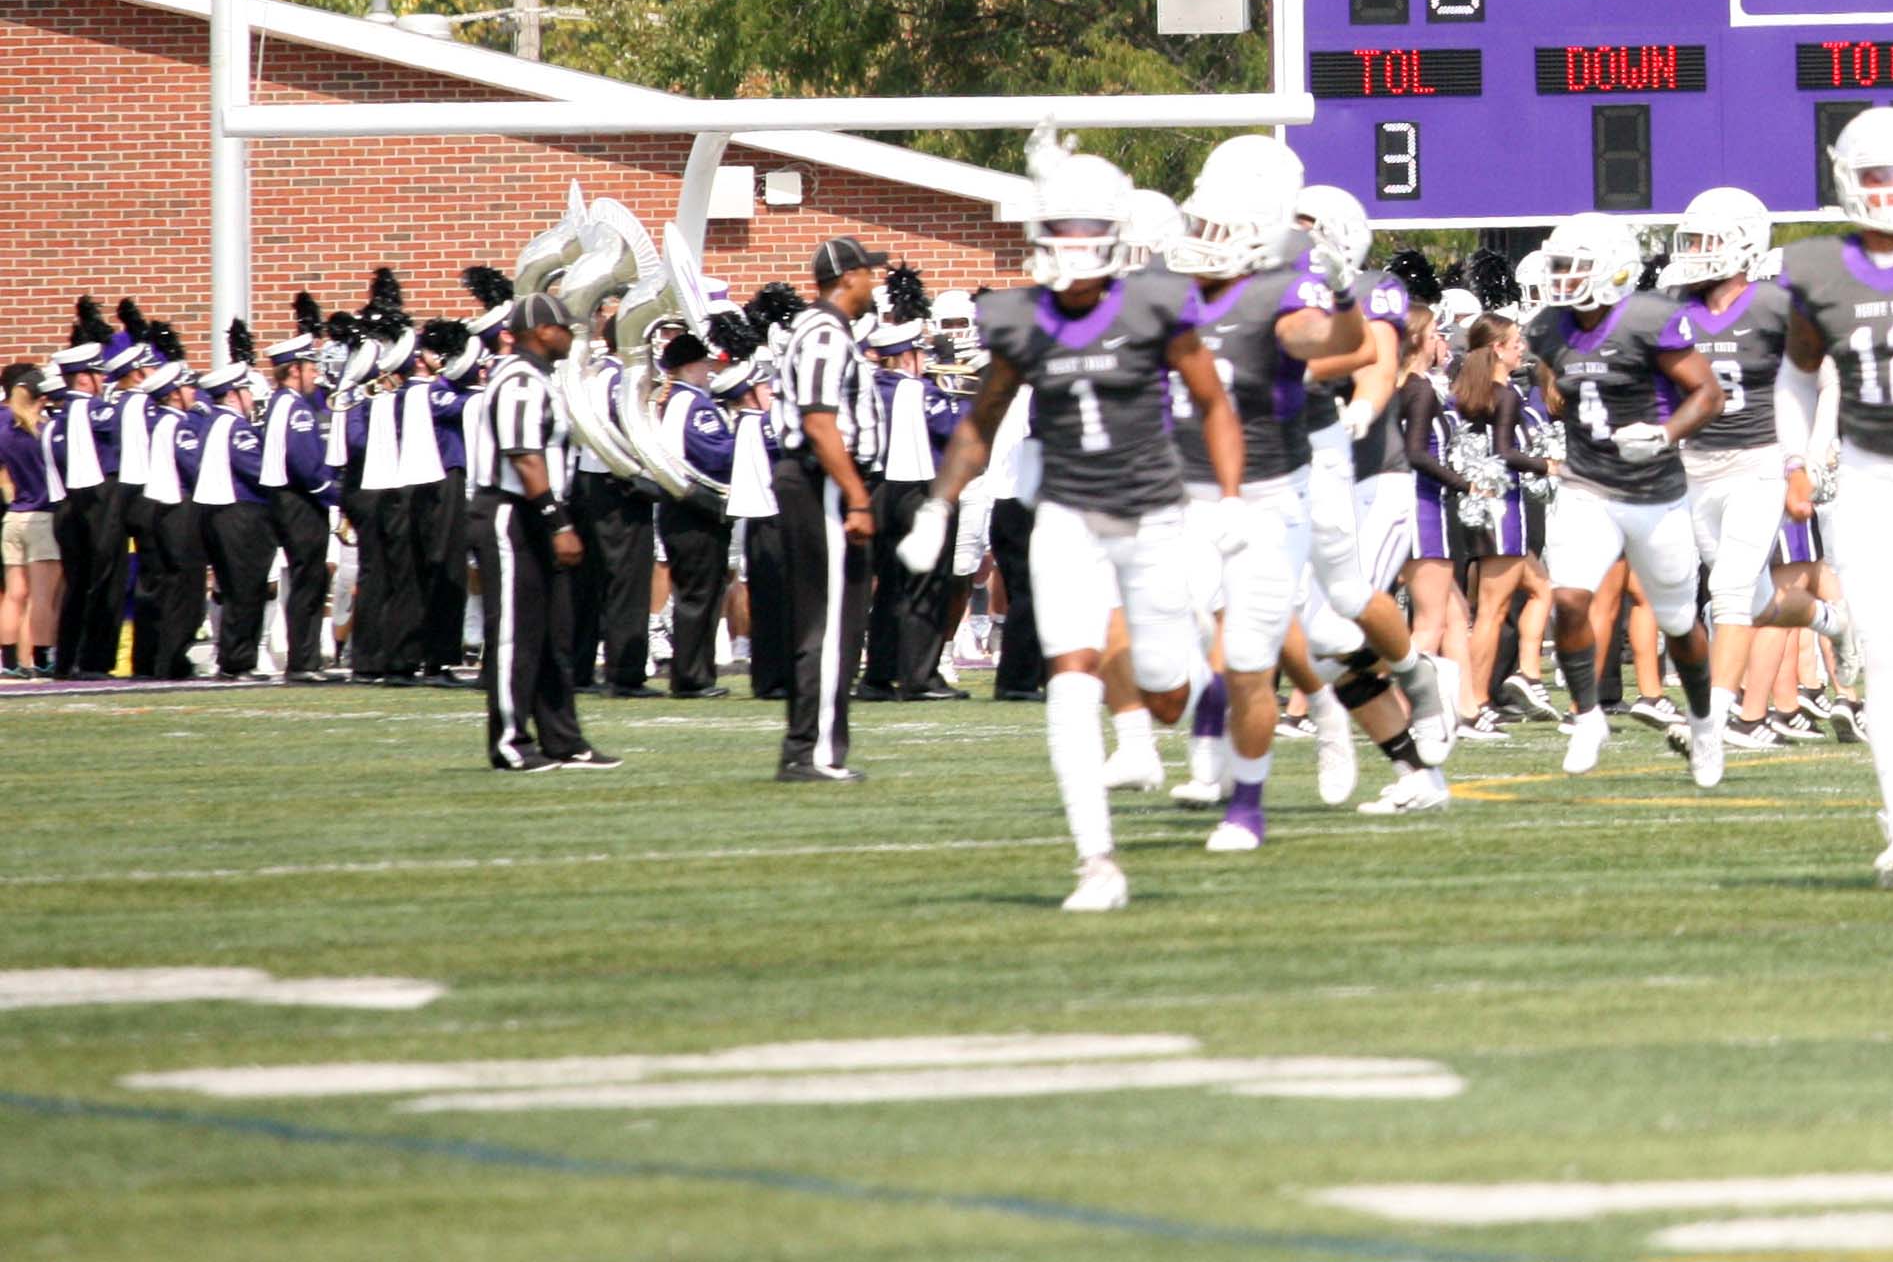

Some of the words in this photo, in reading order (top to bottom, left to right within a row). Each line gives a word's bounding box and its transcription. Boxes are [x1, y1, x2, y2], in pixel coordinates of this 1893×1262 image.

[1354, 49, 1436, 95] TOL
[1565, 44, 1677, 91] DOWN
[1822, 42, 1880, 86] TO
[1381, 122, 1418, 194] 3
[1069, 379, 1113, 452] 1
